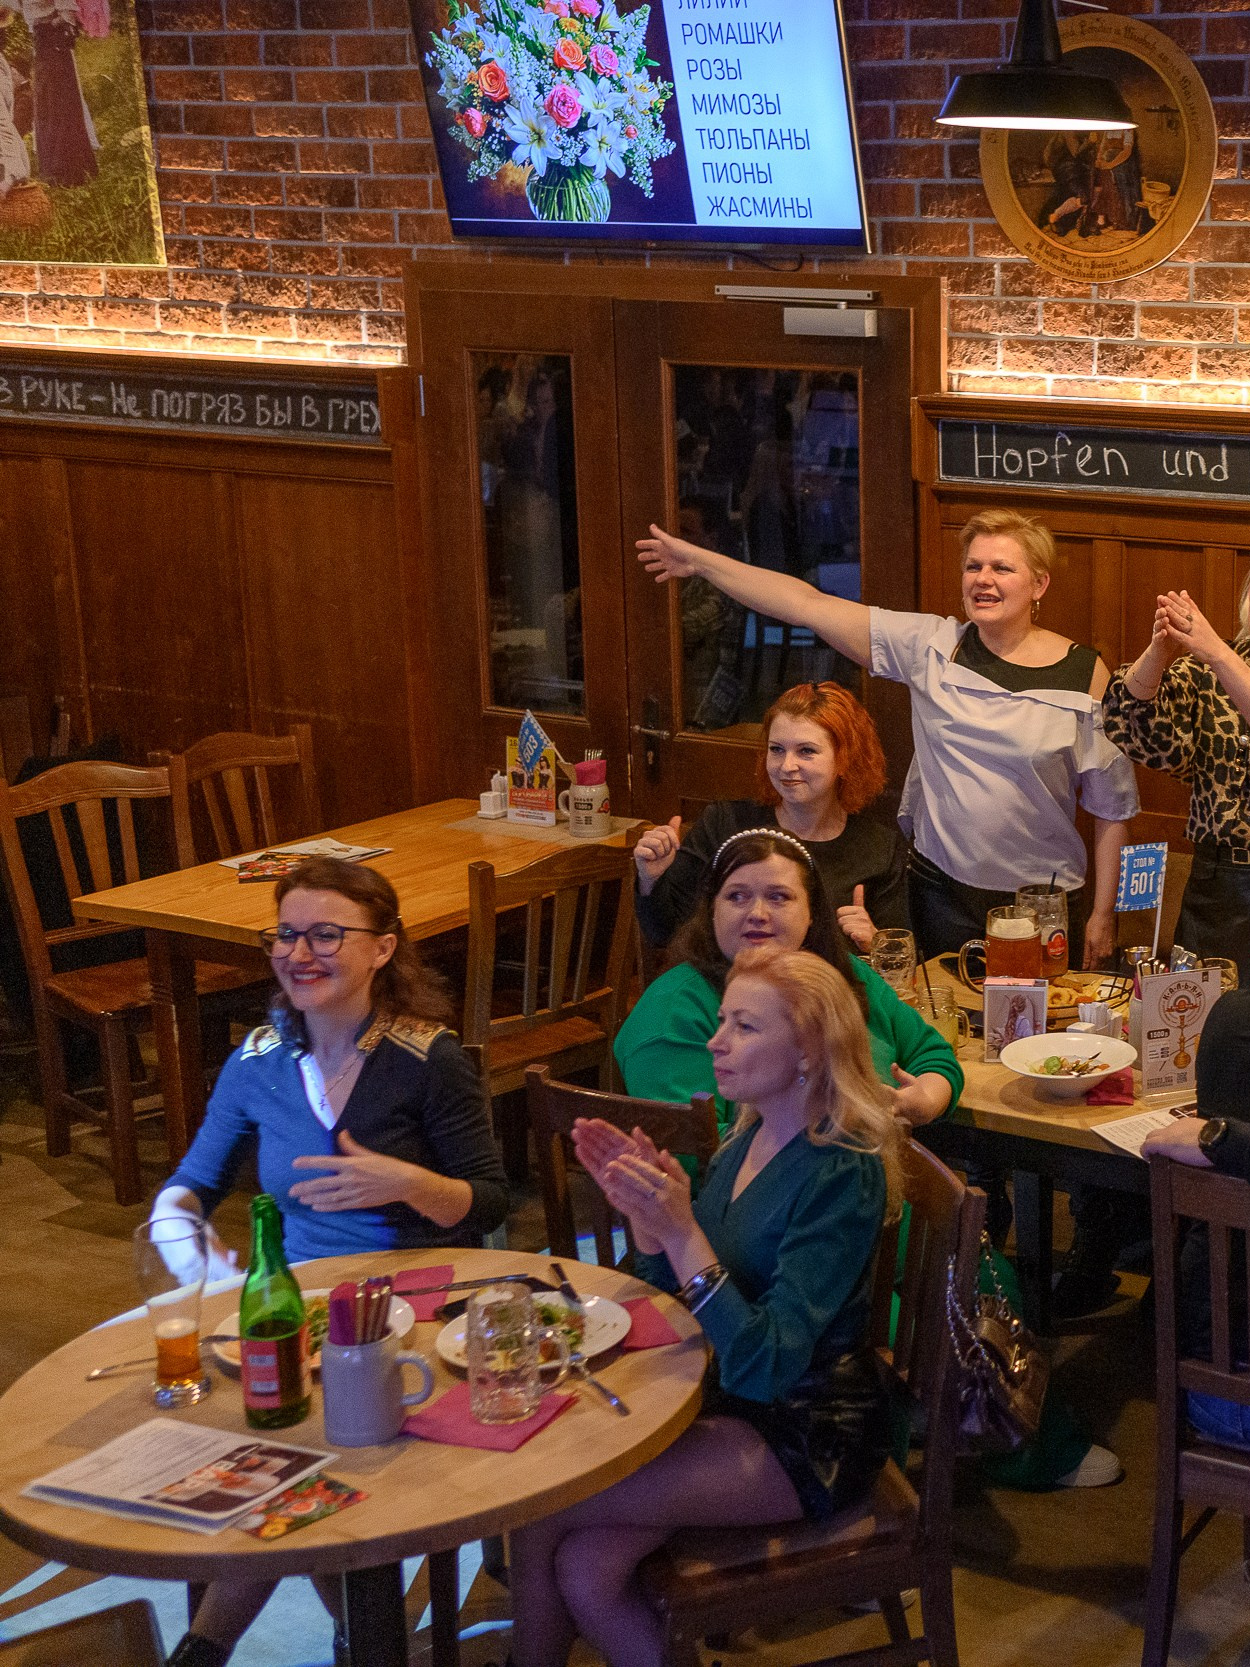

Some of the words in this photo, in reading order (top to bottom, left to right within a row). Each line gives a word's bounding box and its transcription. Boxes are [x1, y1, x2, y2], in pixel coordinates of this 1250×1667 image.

[682, 22, 783, 45] РОМАШКИ
[687, 58, 743, 80] РОЗЫ
[692, 93, 782, 115] МИМОЗЫ
[695, 128, 811, 150] ТЮЛЬПАНЫ
[702, 162, 773, 184] ПИОНЫ
[707, 195, 813, 219] ЖАСМИНЫ
[20, 375, 87, 412] РУКЕ
[151, 388, 247, 426] ПОГРЯЗ
[255, 393, 292, 427] БЫ
[300, 394, 321, 428] В
[972, 424, 1129, 479] Hopfen
[1162, 444, 1230, 482] und
[1129, 870, 1156, 896] 501
